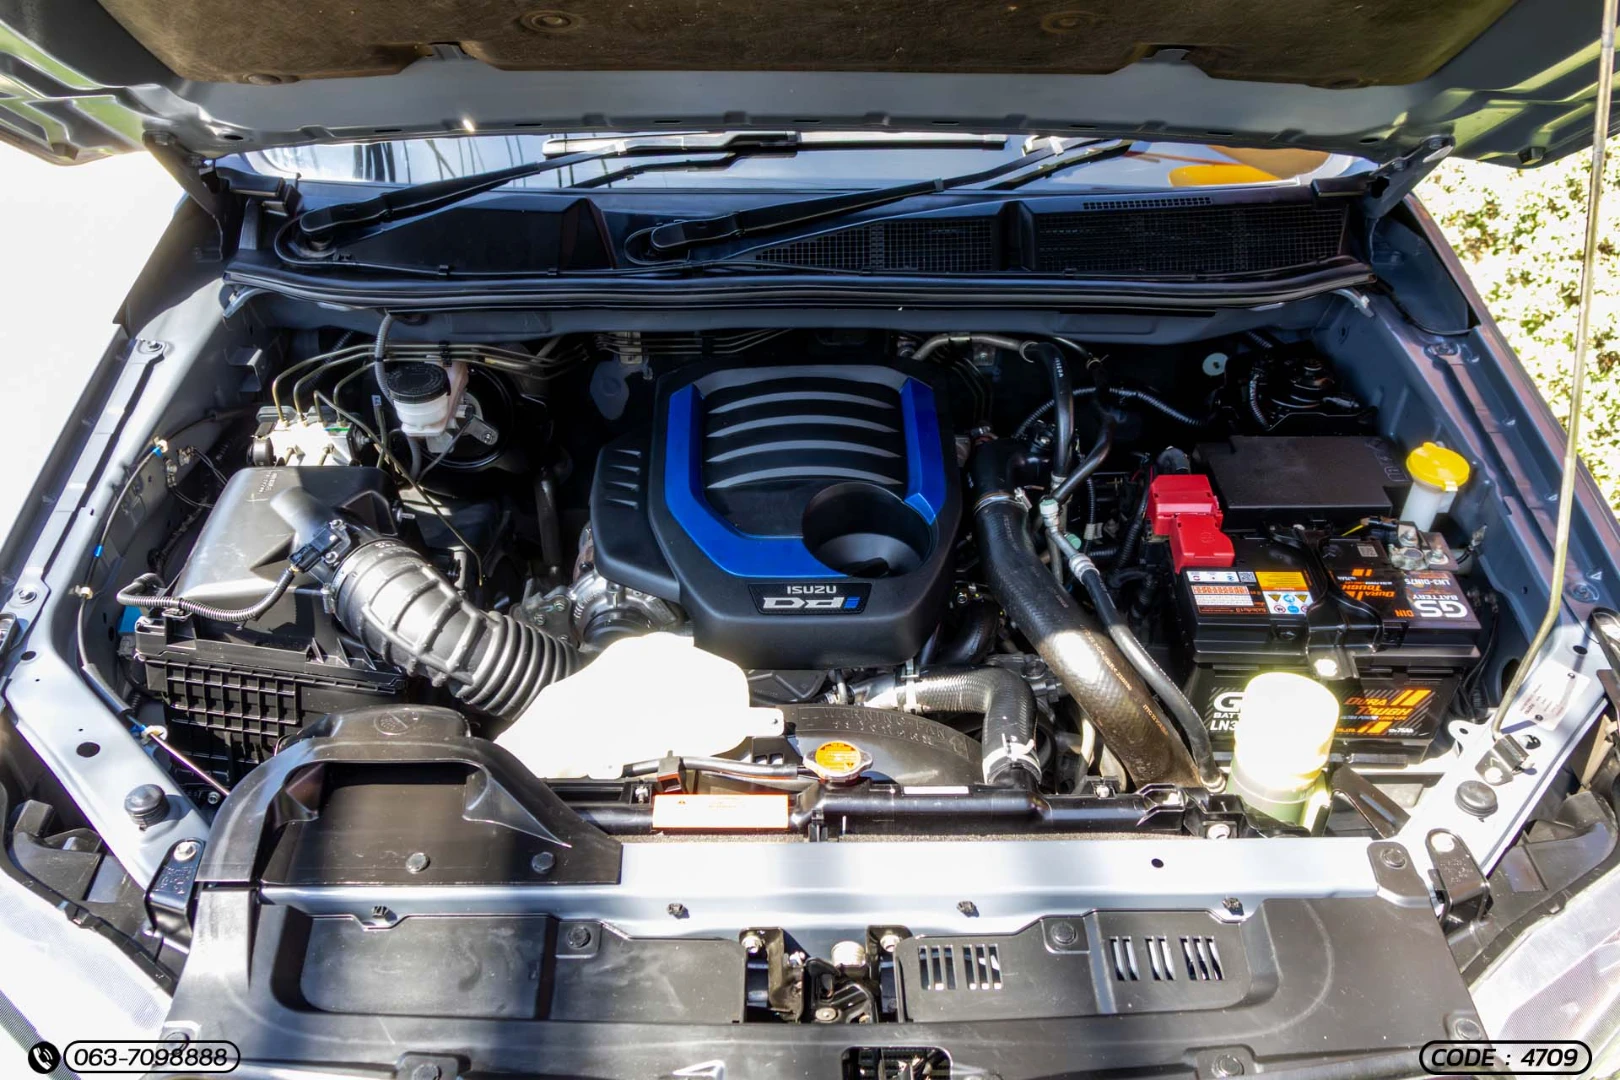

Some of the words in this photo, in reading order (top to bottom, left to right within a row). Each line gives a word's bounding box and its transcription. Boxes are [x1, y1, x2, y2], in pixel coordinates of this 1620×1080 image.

[1404, 578, 1451, 586] LN3-DIN75
[786, 585, 837, 595] ISUZU
[1341, 584, 1382, 592] TOUGH
[1394, 609, 1415, 618] DIN
[1413, 600, 1468, 618] GS
[1213, 691, 1245, 713] G
[1344, 697, 1388, 706] DURA
[1355, 706, 1414, 716] TOUGH
[1210, 720, 1236, 731] LN3
